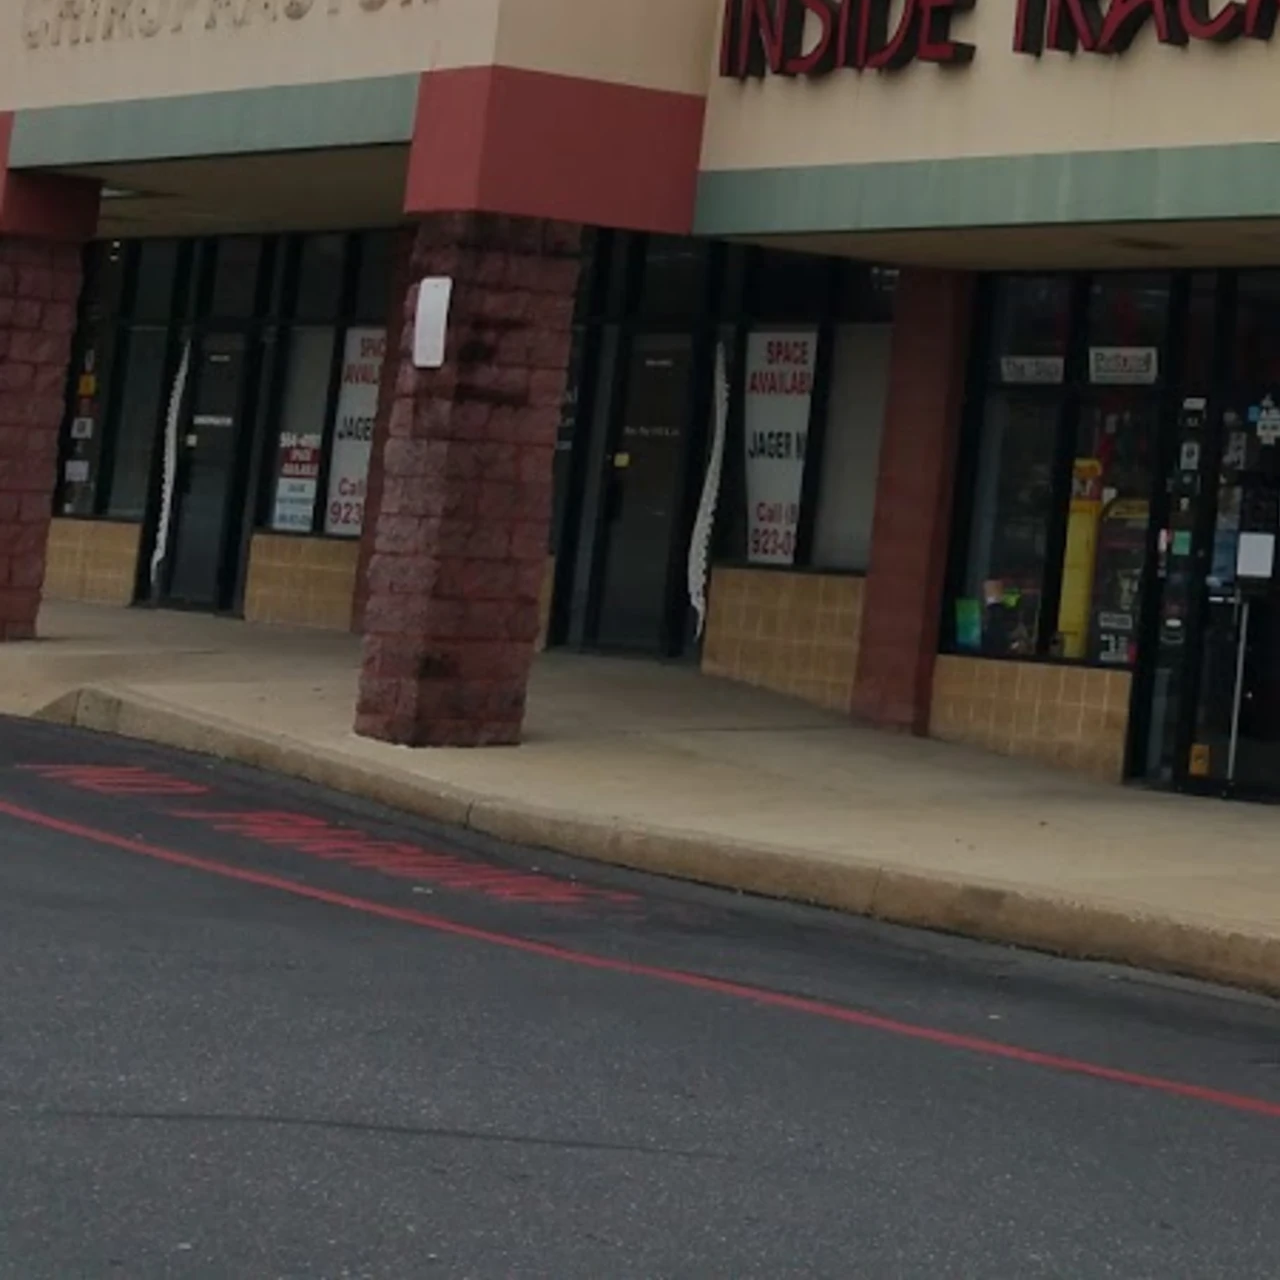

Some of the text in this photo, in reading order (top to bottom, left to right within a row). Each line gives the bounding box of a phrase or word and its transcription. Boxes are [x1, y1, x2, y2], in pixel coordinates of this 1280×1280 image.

[361, 337, 386, 358] SPAC
[766, 339, 810, 364] SPACE
[342, 363, 382, 385] AVAIL
[748, 369, 812, 396] AVAILAB
[338, 416, 374, 441] JAGE
[747, 430, 792, 460] JAGER
[338, 476, 364, 497] Cal
